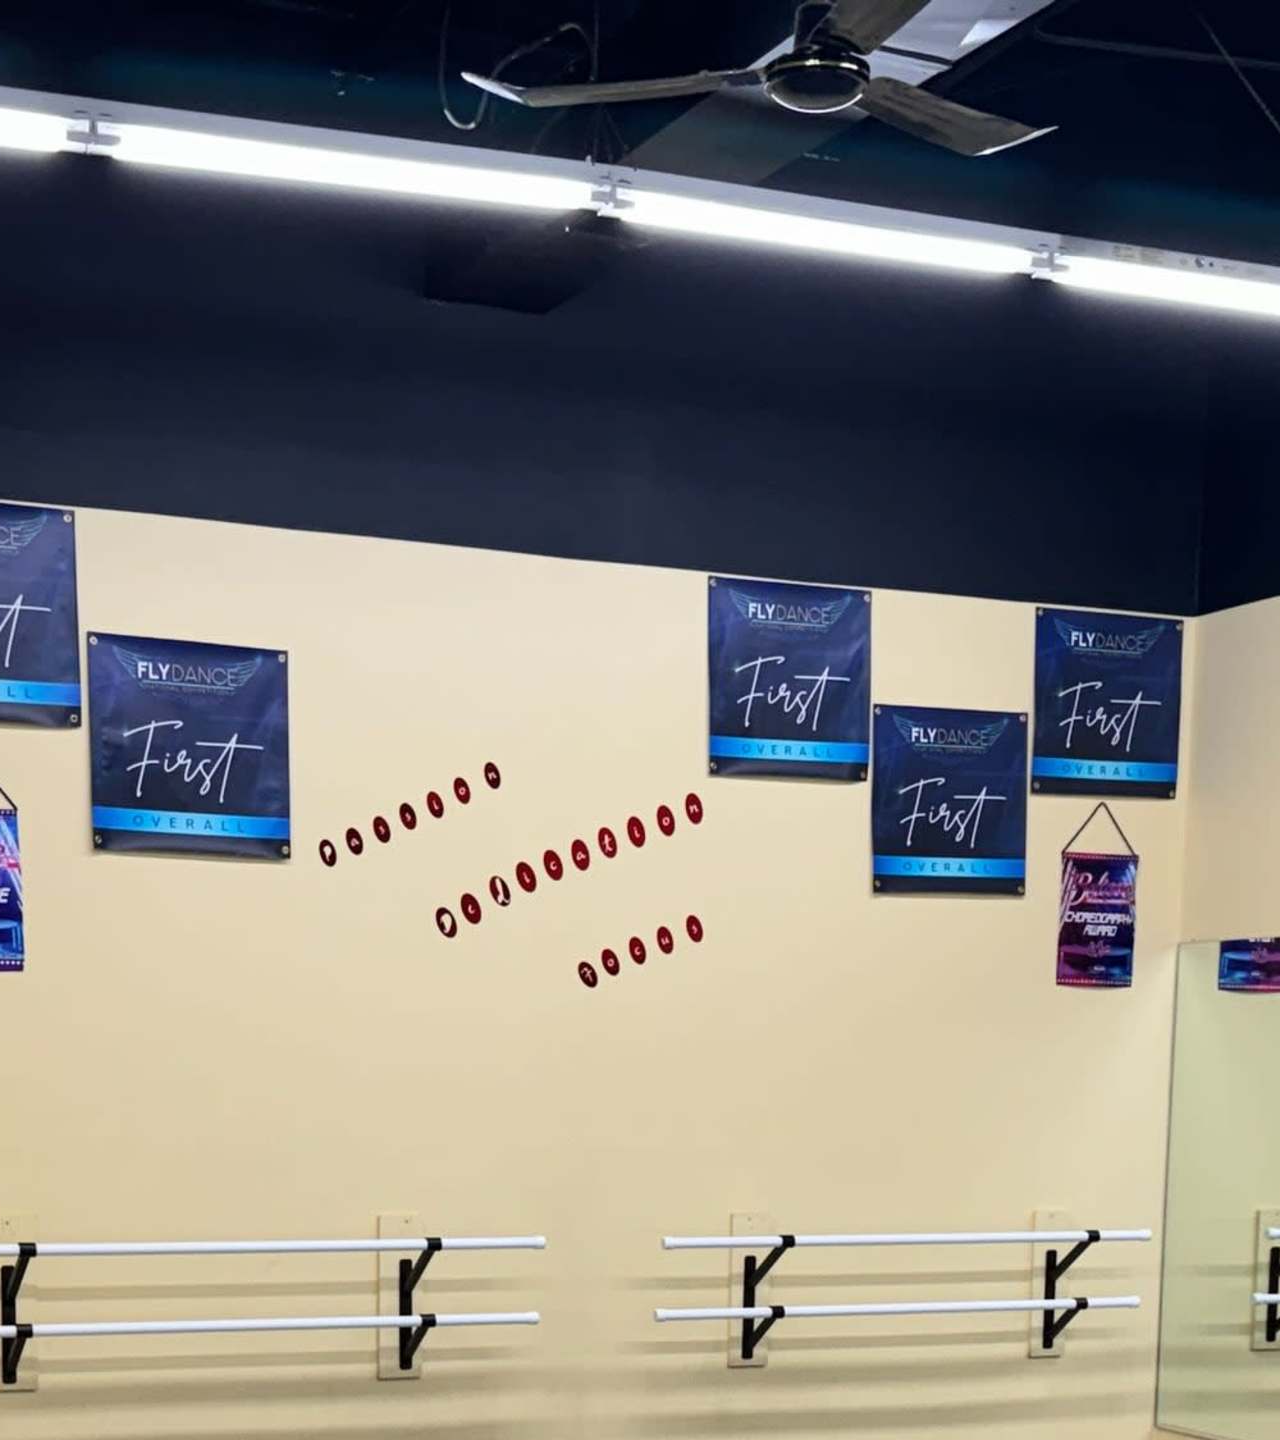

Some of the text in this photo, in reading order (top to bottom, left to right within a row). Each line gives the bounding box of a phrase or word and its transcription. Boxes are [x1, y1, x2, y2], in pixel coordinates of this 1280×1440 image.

[735, 656, 850, 731] First
[1058, 681, 1162, 752] First
[741, 743, 833, 758] OVERALL
[123, 720, 264, 803] First
[1060, 764, 1144, 777] OVERALL
[898, 777, 1007, 849] First
[132, 815, 246, 833] OVERALL
[903, 862, 992, 874] OVERALL
[1083, 924, 1118, 937] AWARD
